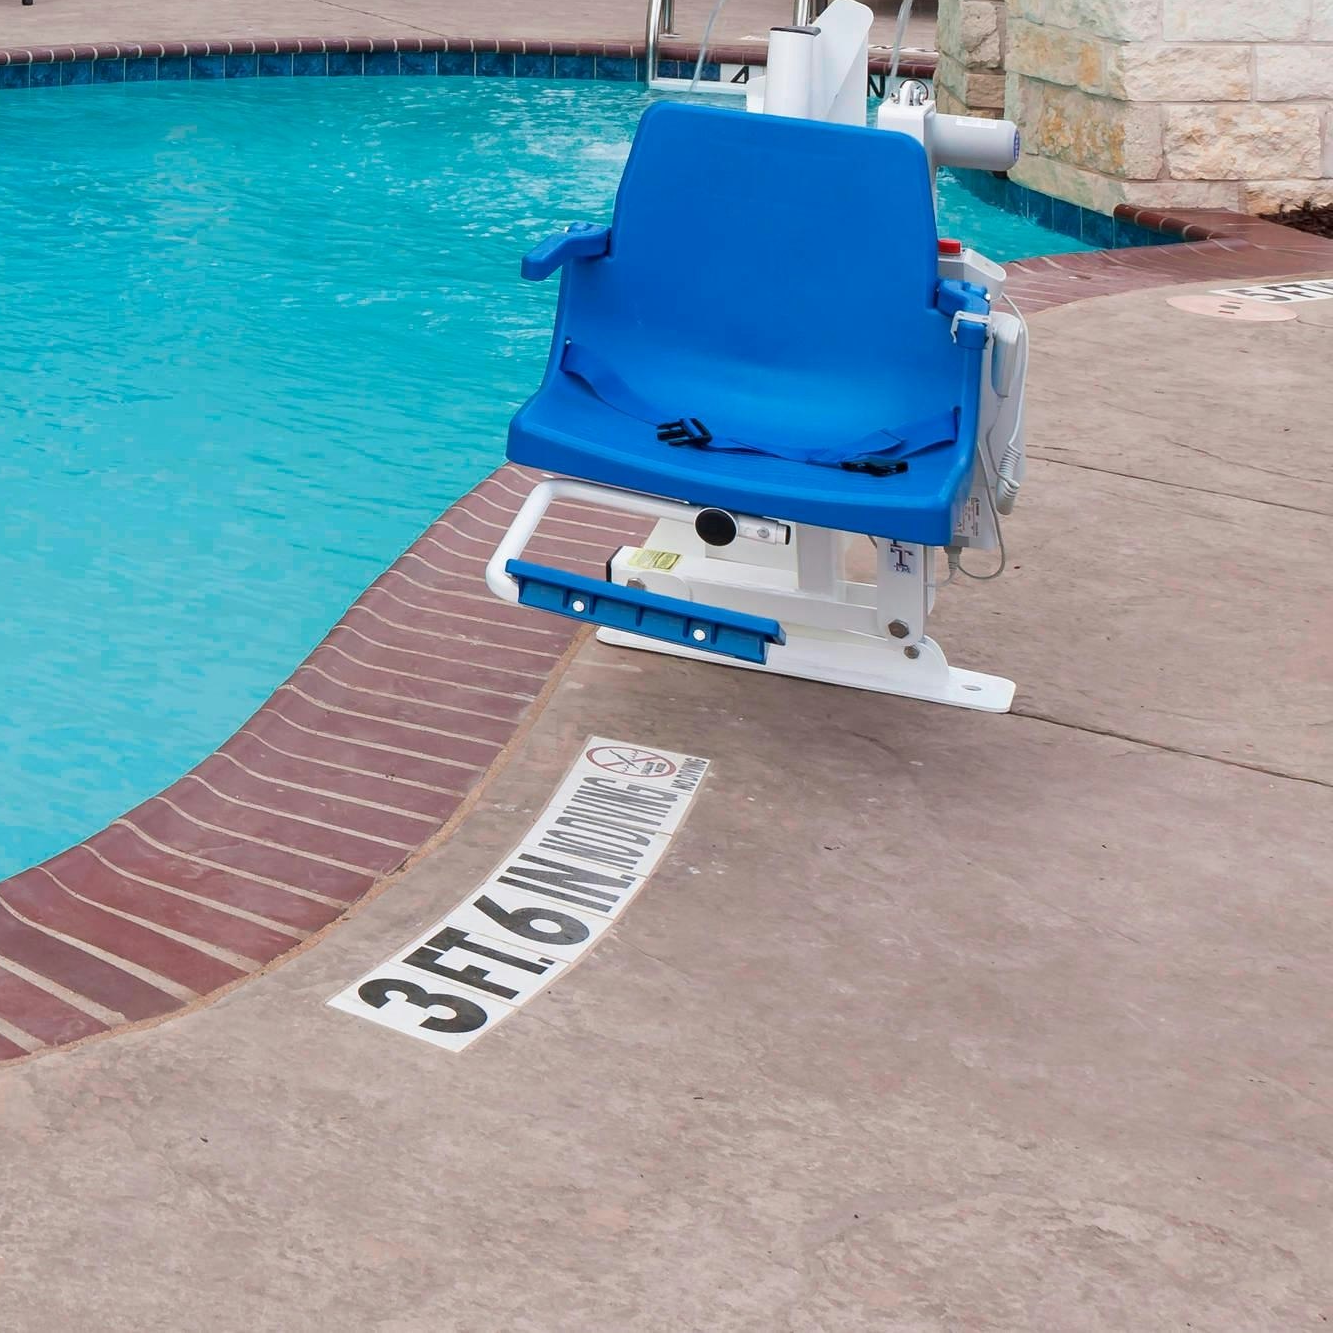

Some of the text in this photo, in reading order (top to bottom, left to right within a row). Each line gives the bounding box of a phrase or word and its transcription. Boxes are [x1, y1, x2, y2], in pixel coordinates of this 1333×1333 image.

[670, 757, 708, 792] NO DIVING
[555, 777, 678, 847] DIVING
[538, 829, 644, 870] NO
[473, 894, 591, 946] 6
[357, 977, 489, 1034] 3
